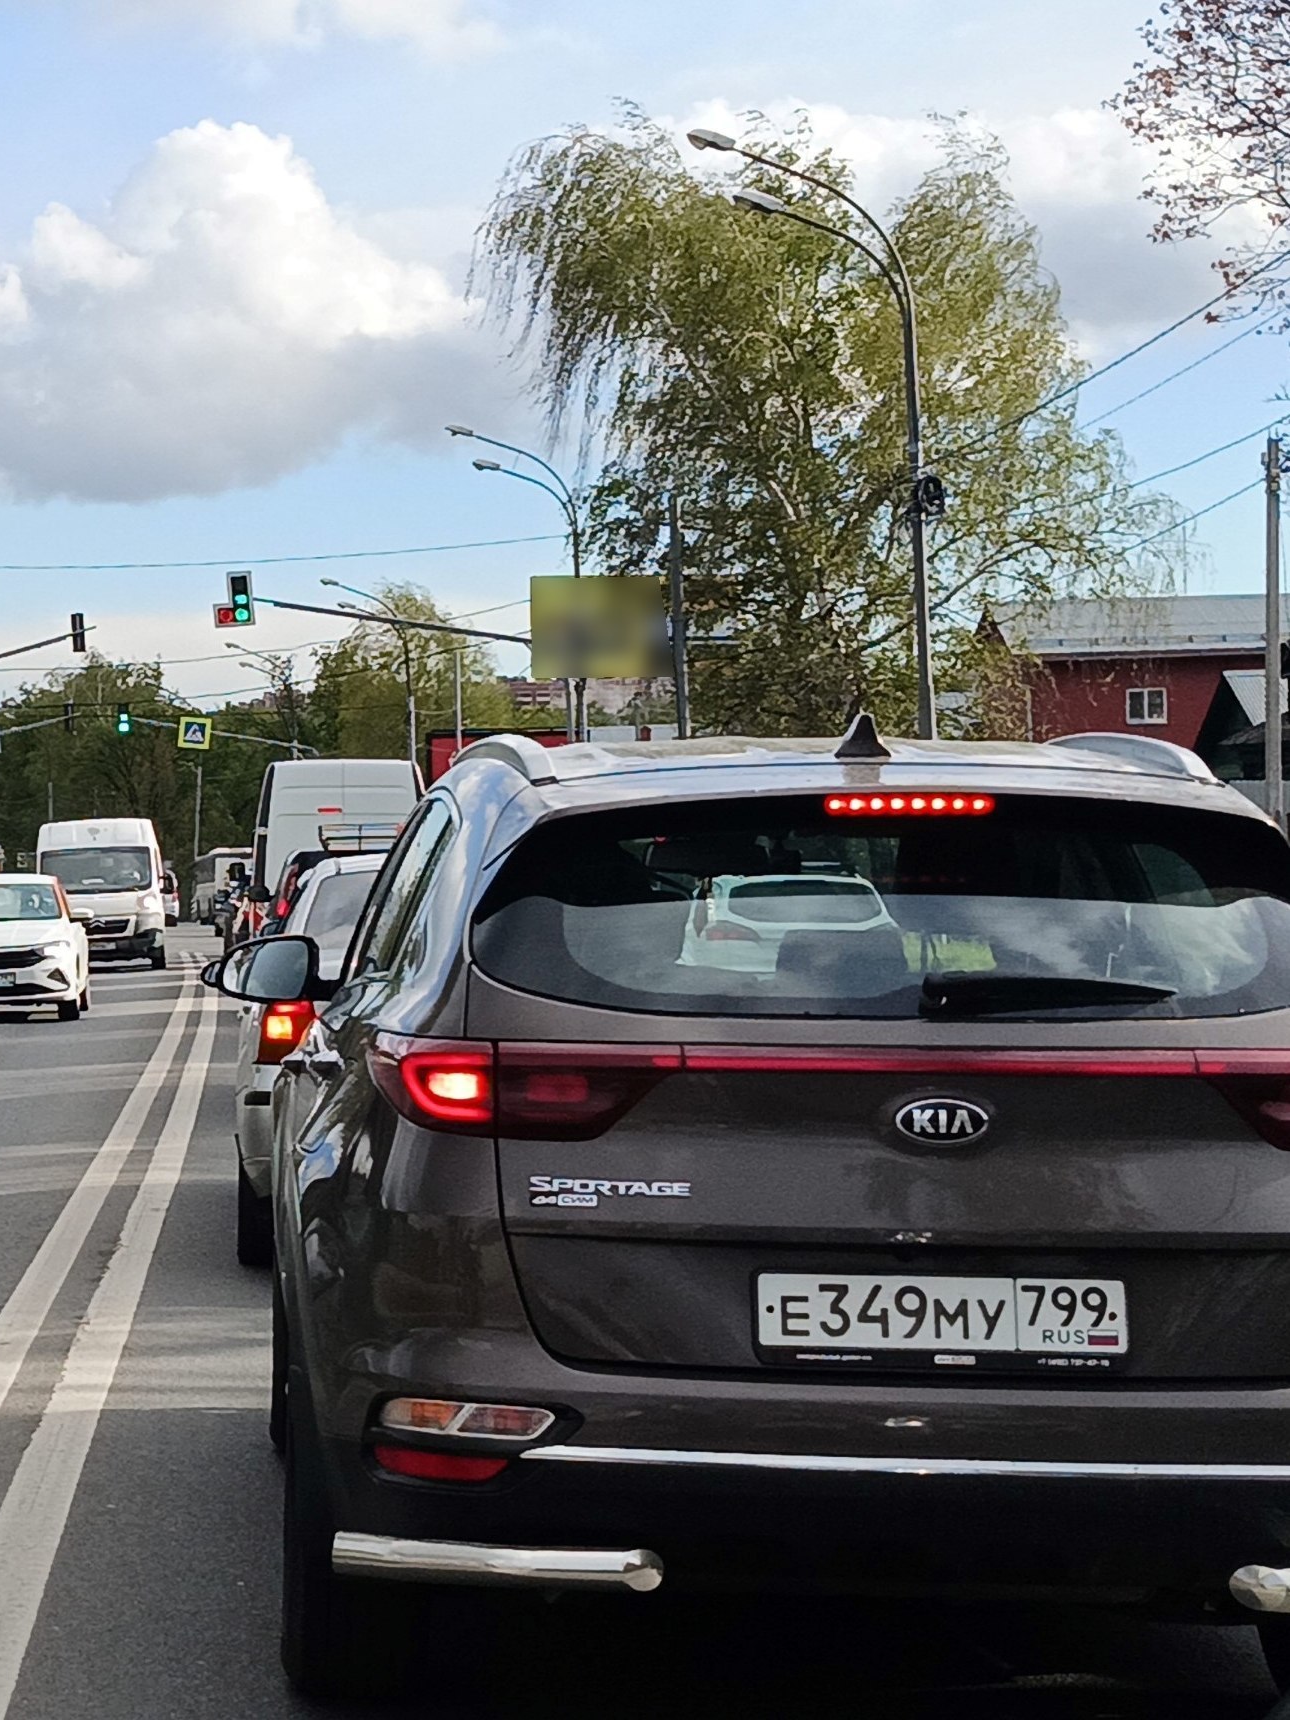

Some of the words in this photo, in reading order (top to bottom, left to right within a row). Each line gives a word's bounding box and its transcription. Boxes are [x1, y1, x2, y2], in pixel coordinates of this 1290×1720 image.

[911, 1108, 974, 1134] KIA
[528, 1175, 692, 1197] SPORTAGE
[1020, 1284, 1109, 1328] 799
[1042, 1328, 1086, 1345] RUS
